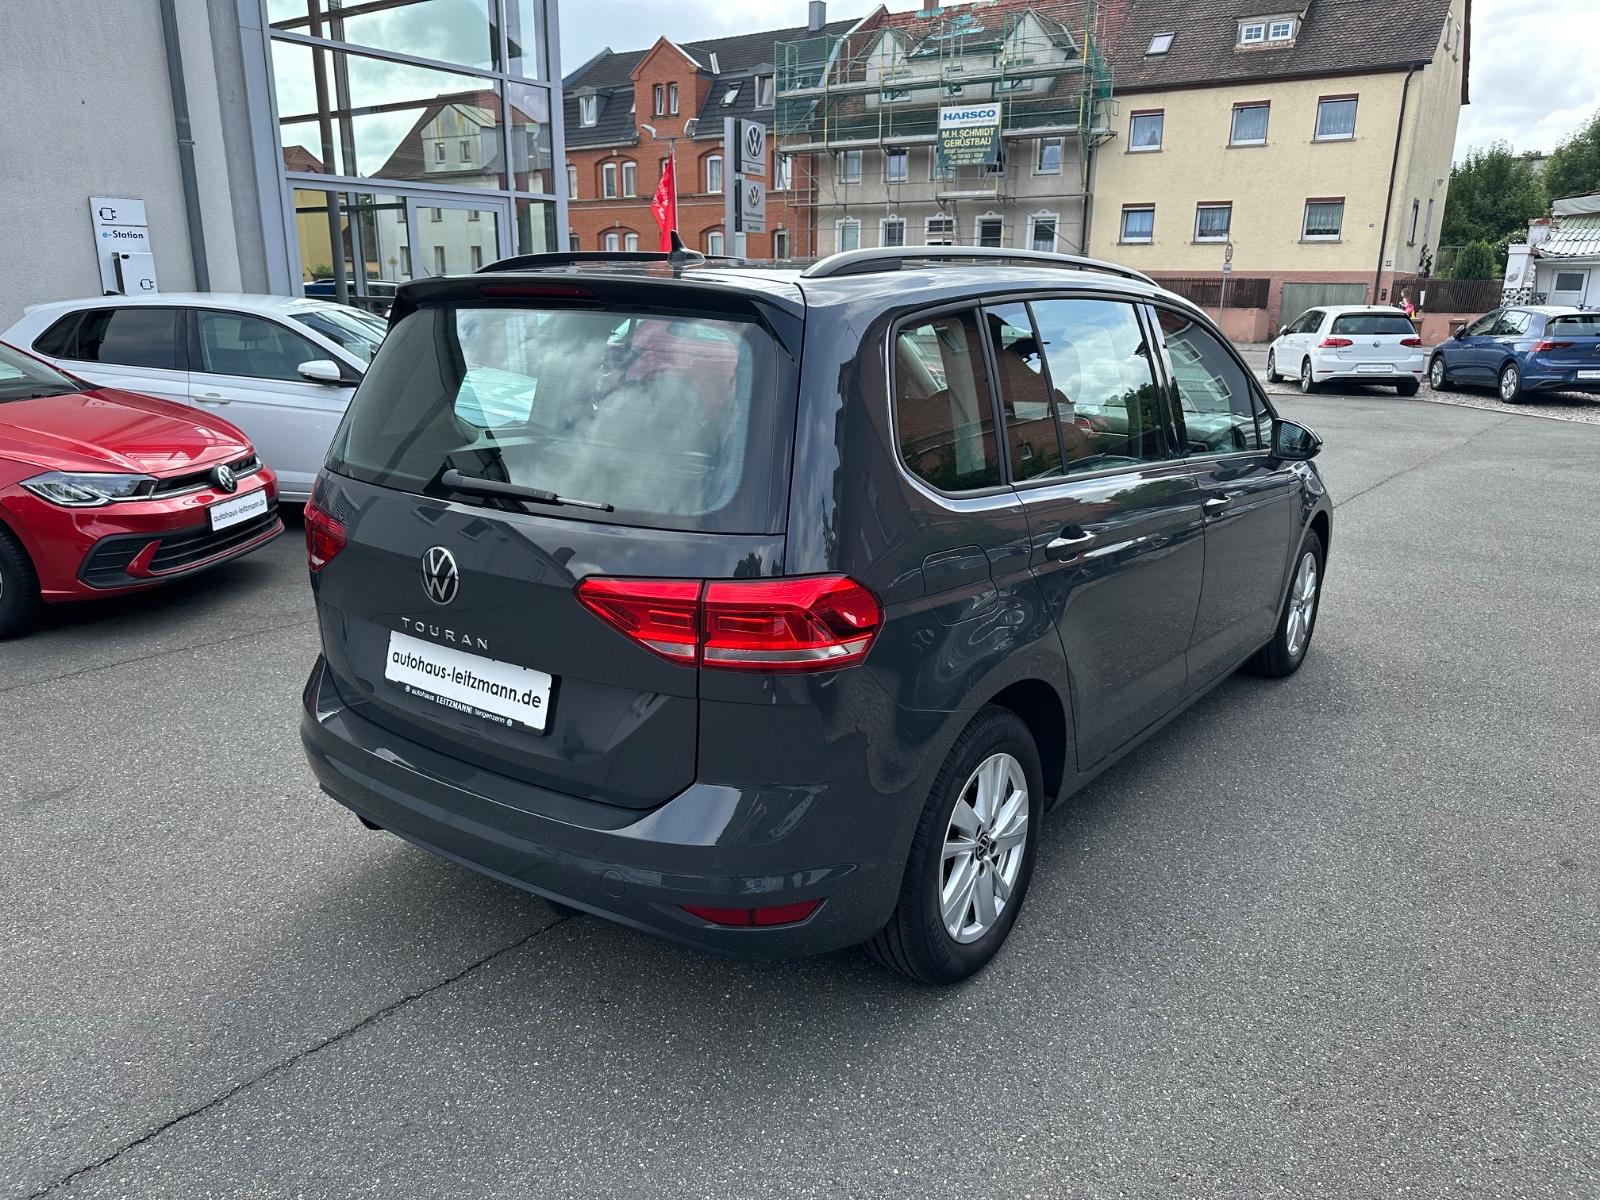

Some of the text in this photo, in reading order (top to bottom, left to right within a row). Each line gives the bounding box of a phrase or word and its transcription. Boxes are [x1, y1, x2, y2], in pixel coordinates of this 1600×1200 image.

[943, 109, 996, 121] HARSCO
[944, 137, 991, 148] GERÜSTBAU
[102, 230, 144, 239] e-Station
[213, 499, 265, 522] autohaus-leitzmann.de
[401, 617, 489, 650] TOURAN
[392, 650, 542, 709] autohaus-leitzmann.de
[411, 688, 434, 701] autohaus
[436, 695, 473, 715] LEITZMANN
